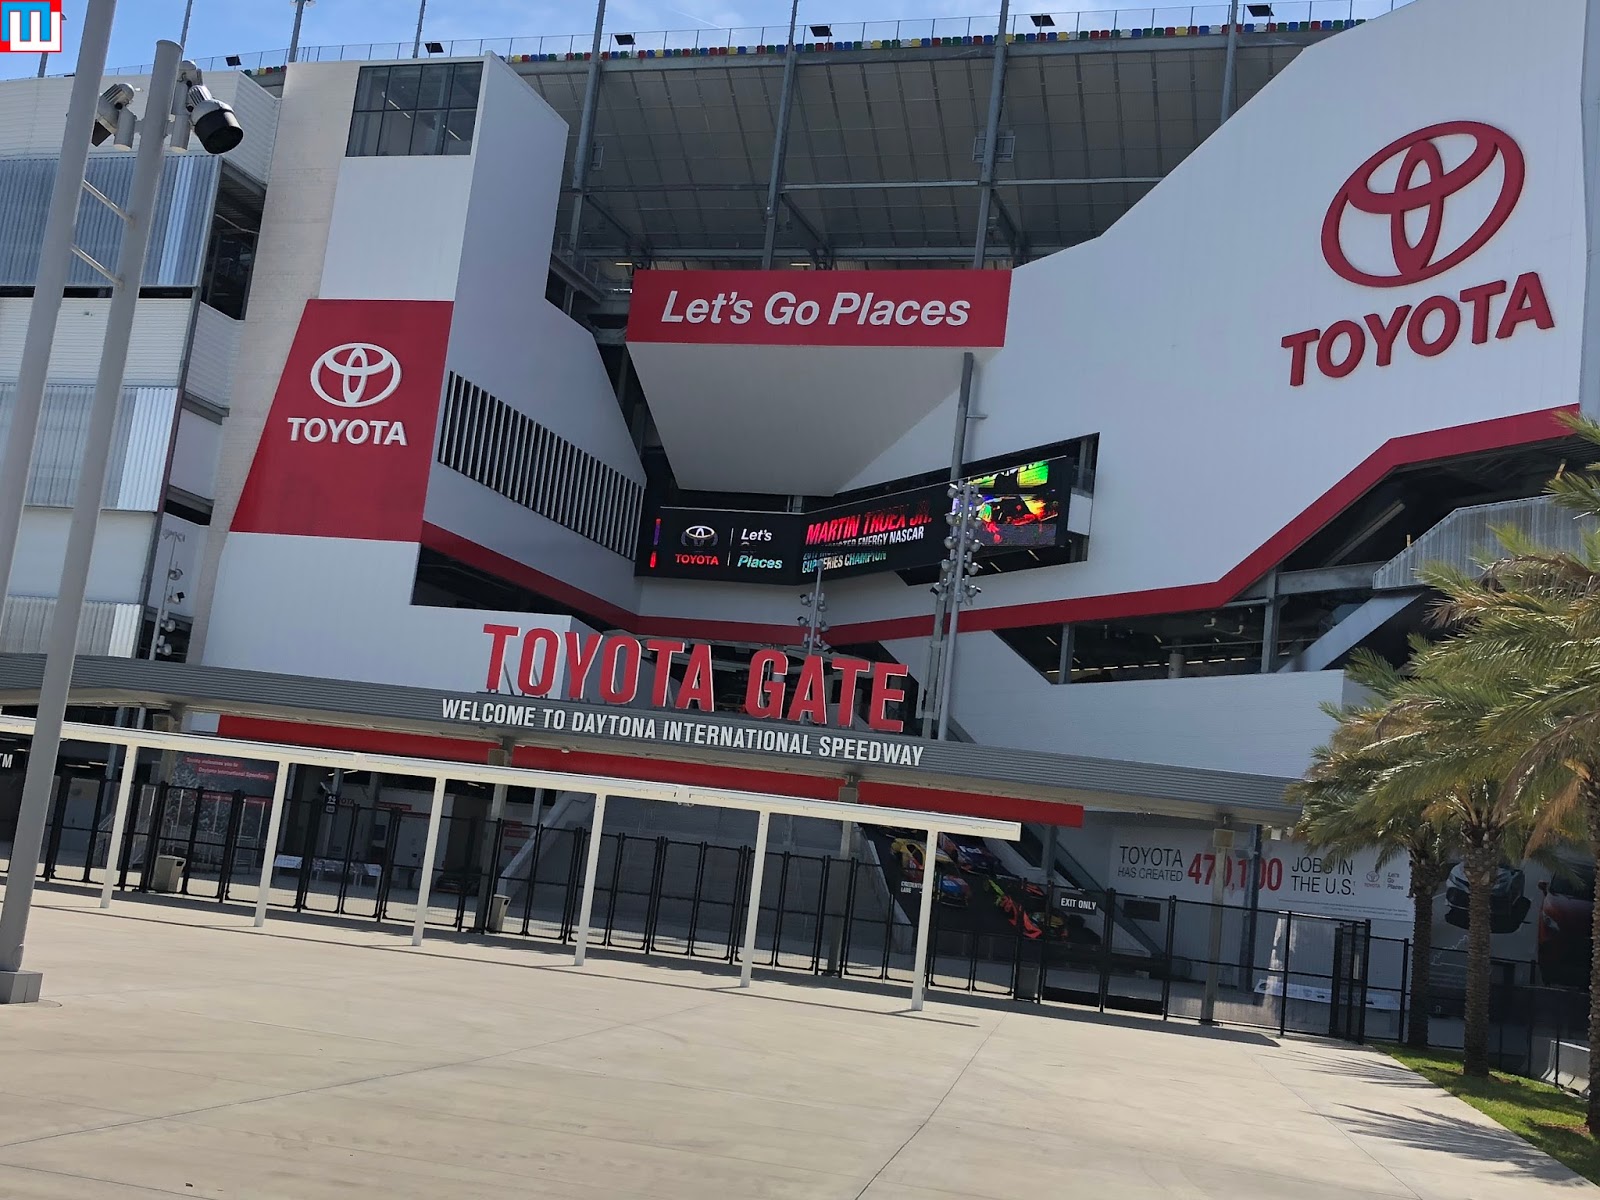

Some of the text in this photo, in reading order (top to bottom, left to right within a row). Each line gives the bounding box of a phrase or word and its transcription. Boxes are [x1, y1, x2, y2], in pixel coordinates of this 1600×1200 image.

[764, 291, 820, 325] Go
[828, 292, 971, 326] Places
[1281, 272, 1555, 387] TOYOTA
[288, 417, 407, 446] TOYOTA
[805, 514, 860, 546] MARTIN
[889, 526, 925, 545] NASCAR
[675, 554, 719, 565] TOYOTA
[737, 555, 783, 569] Places
[819, 555, 843, 571] ERIES
[844, 551, 887, 567] CHAMPION
[483, 624, 909, 733] TOYOTA GATE
[442, 698, 924, 767] WELCOME TO DAYTONA INTERNATIONAL SPEEDWAY
[1119, 846, 1183, 868] TOYOTA
[1117, 867, 1183, 882] HAS CREATED
[1291, 875, 1321, 893] THE
[1061, 897, 1097, 911] EXIT ONLY
